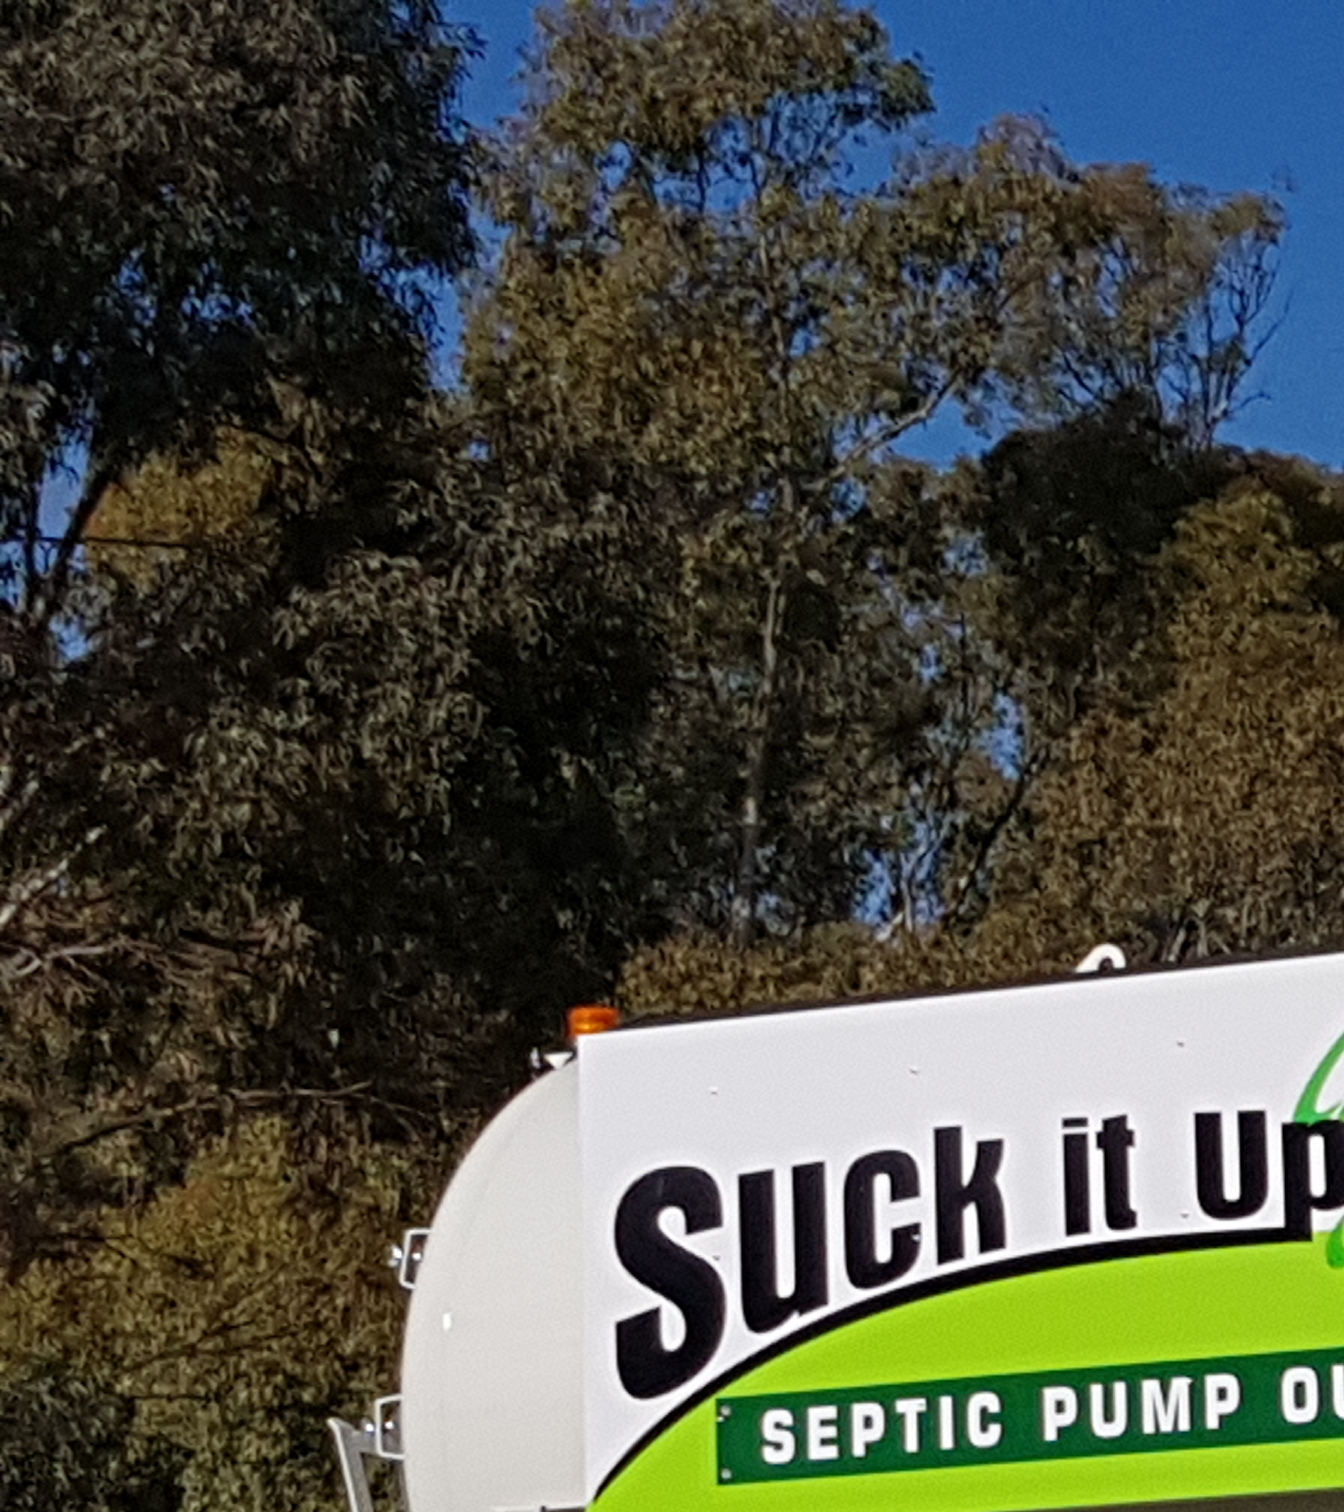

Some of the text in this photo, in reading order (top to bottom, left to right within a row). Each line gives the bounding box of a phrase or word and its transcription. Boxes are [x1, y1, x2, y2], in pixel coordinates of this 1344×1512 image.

[614, 1126, 1006, 1400] Suck
[1062, 1115, 1137, 1237] it
[761, 1391, 1002, 1465] SEPTIC
[1042, 1373, 1240, 1442] PUMP
